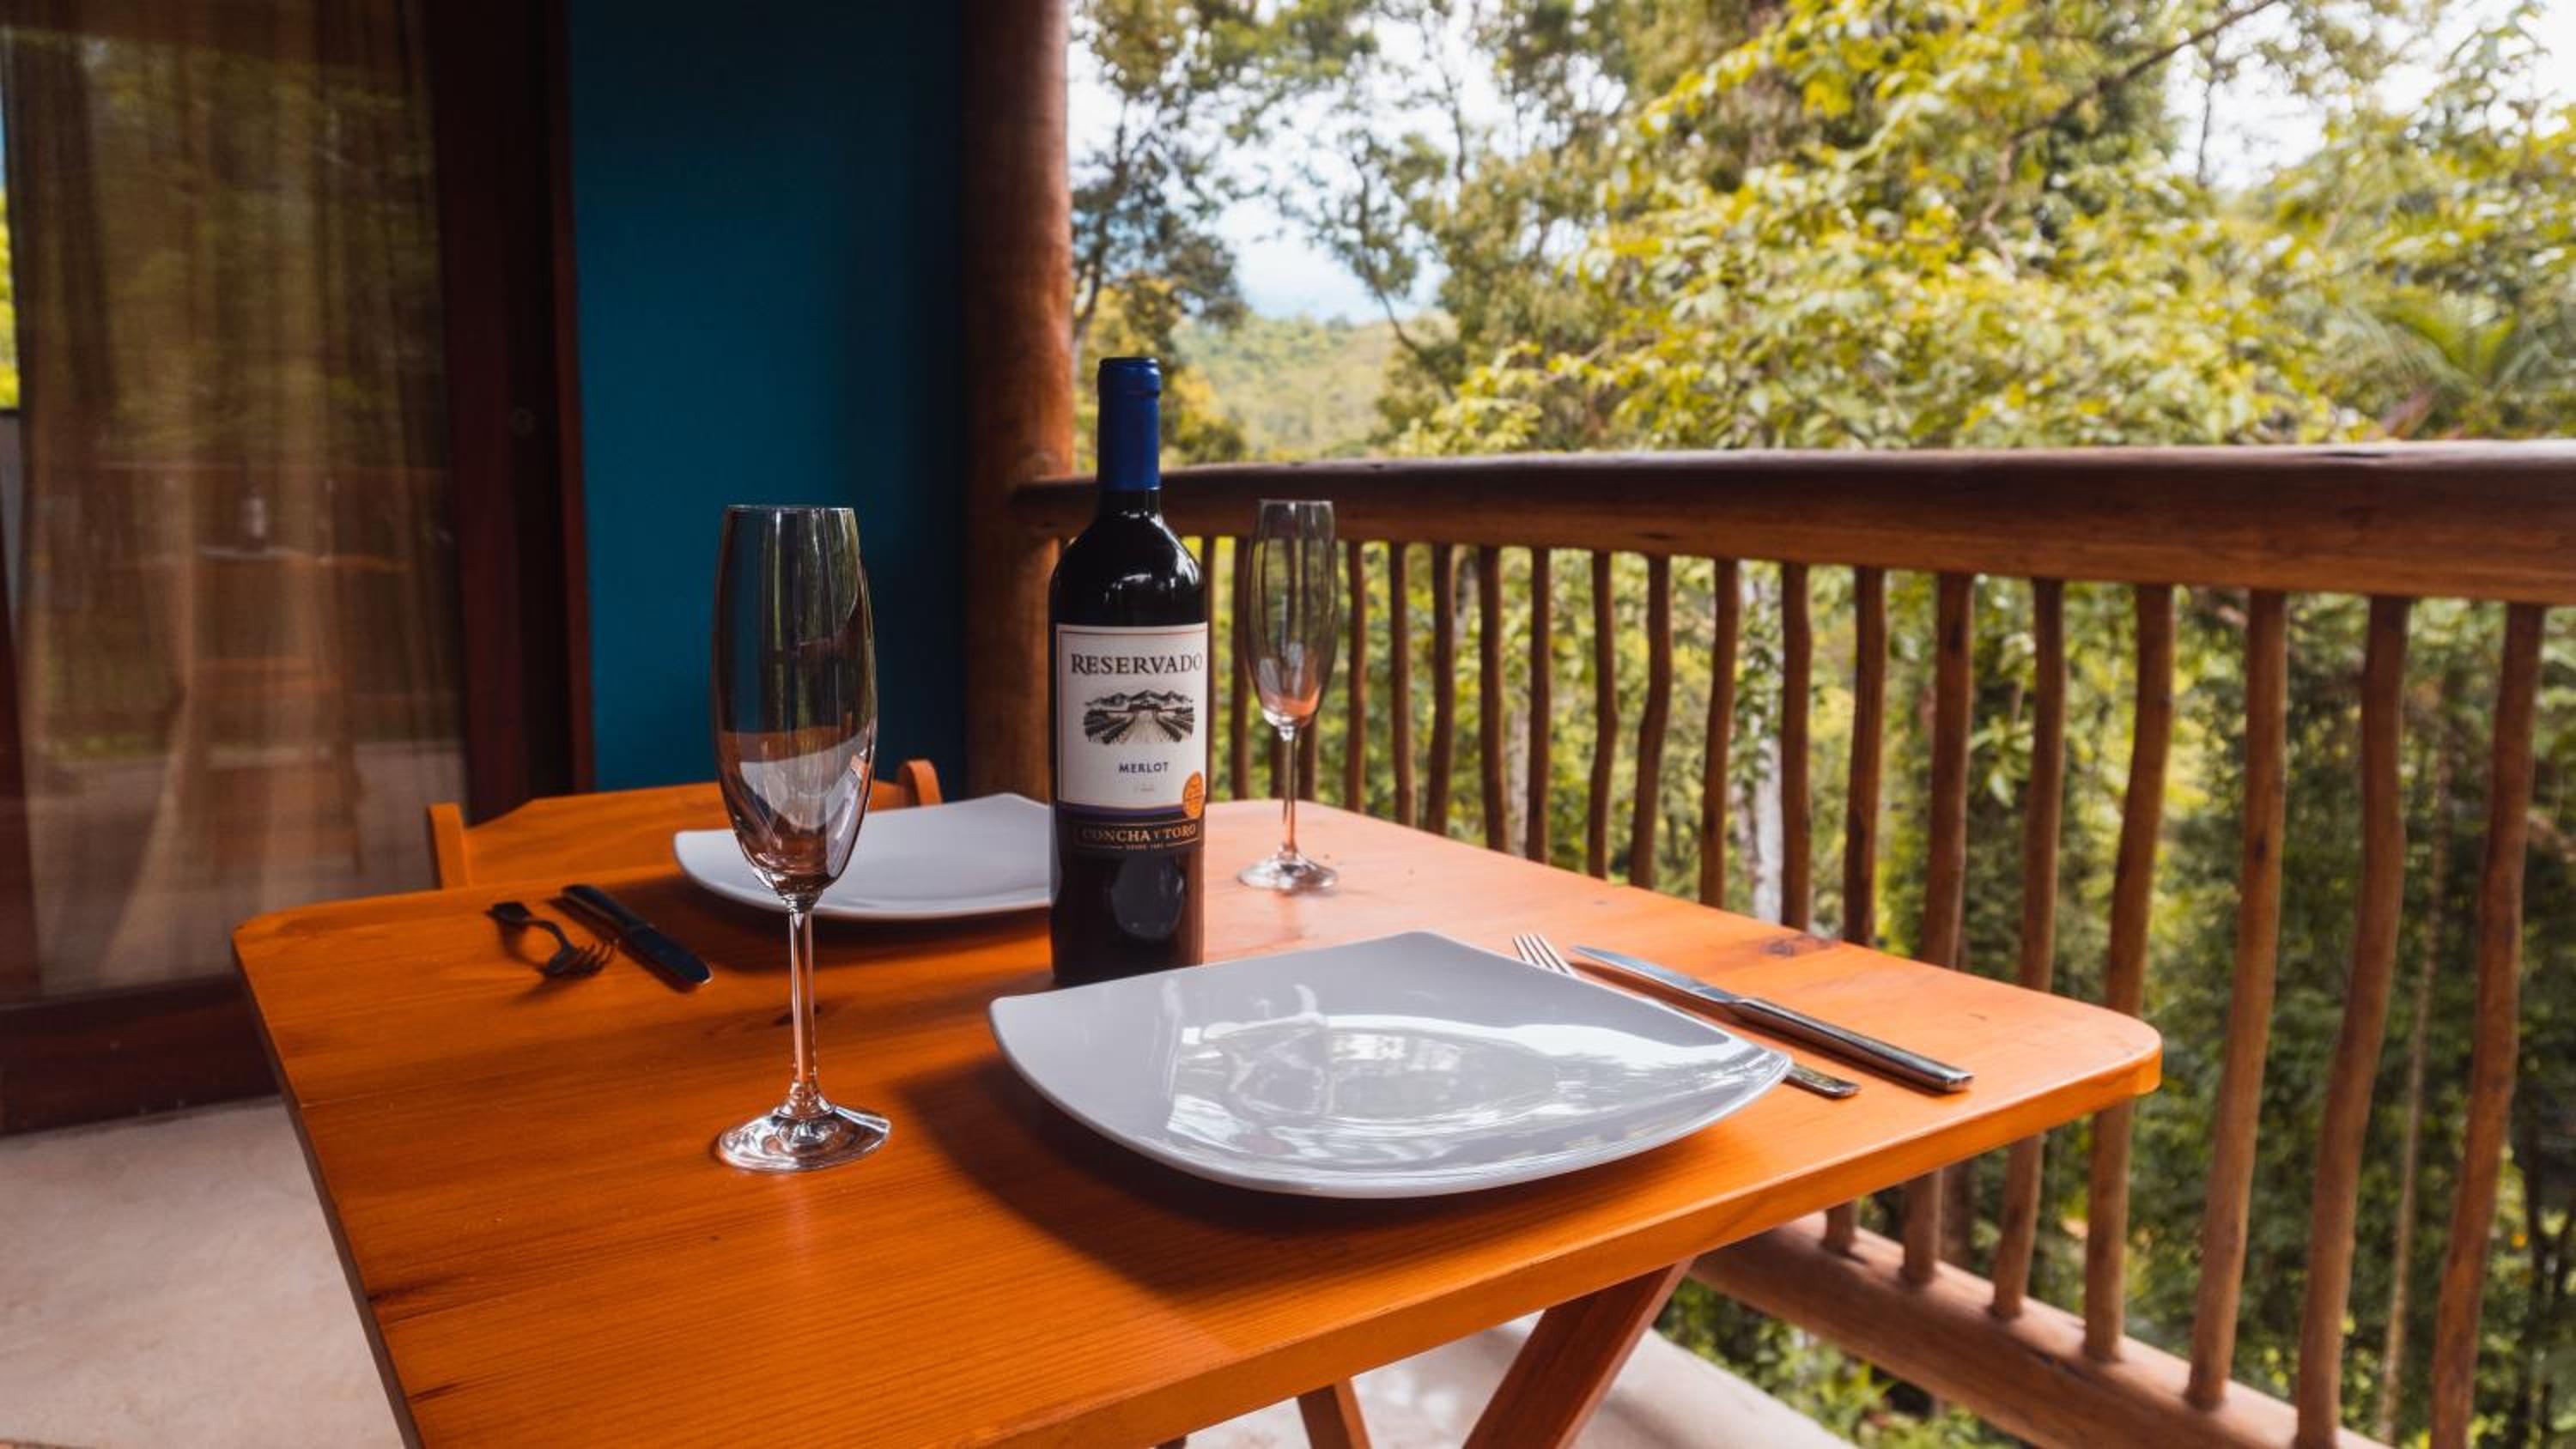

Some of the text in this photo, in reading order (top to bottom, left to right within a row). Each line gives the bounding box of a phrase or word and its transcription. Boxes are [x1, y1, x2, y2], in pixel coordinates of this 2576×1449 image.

[1071, 653, 1203, 675] RESERVADO
[1118, 761, 1169, 773] MERLOT
[1083, 827, 1151, 843] CONCHA
[1162, 823, 1197, 840] TORO
